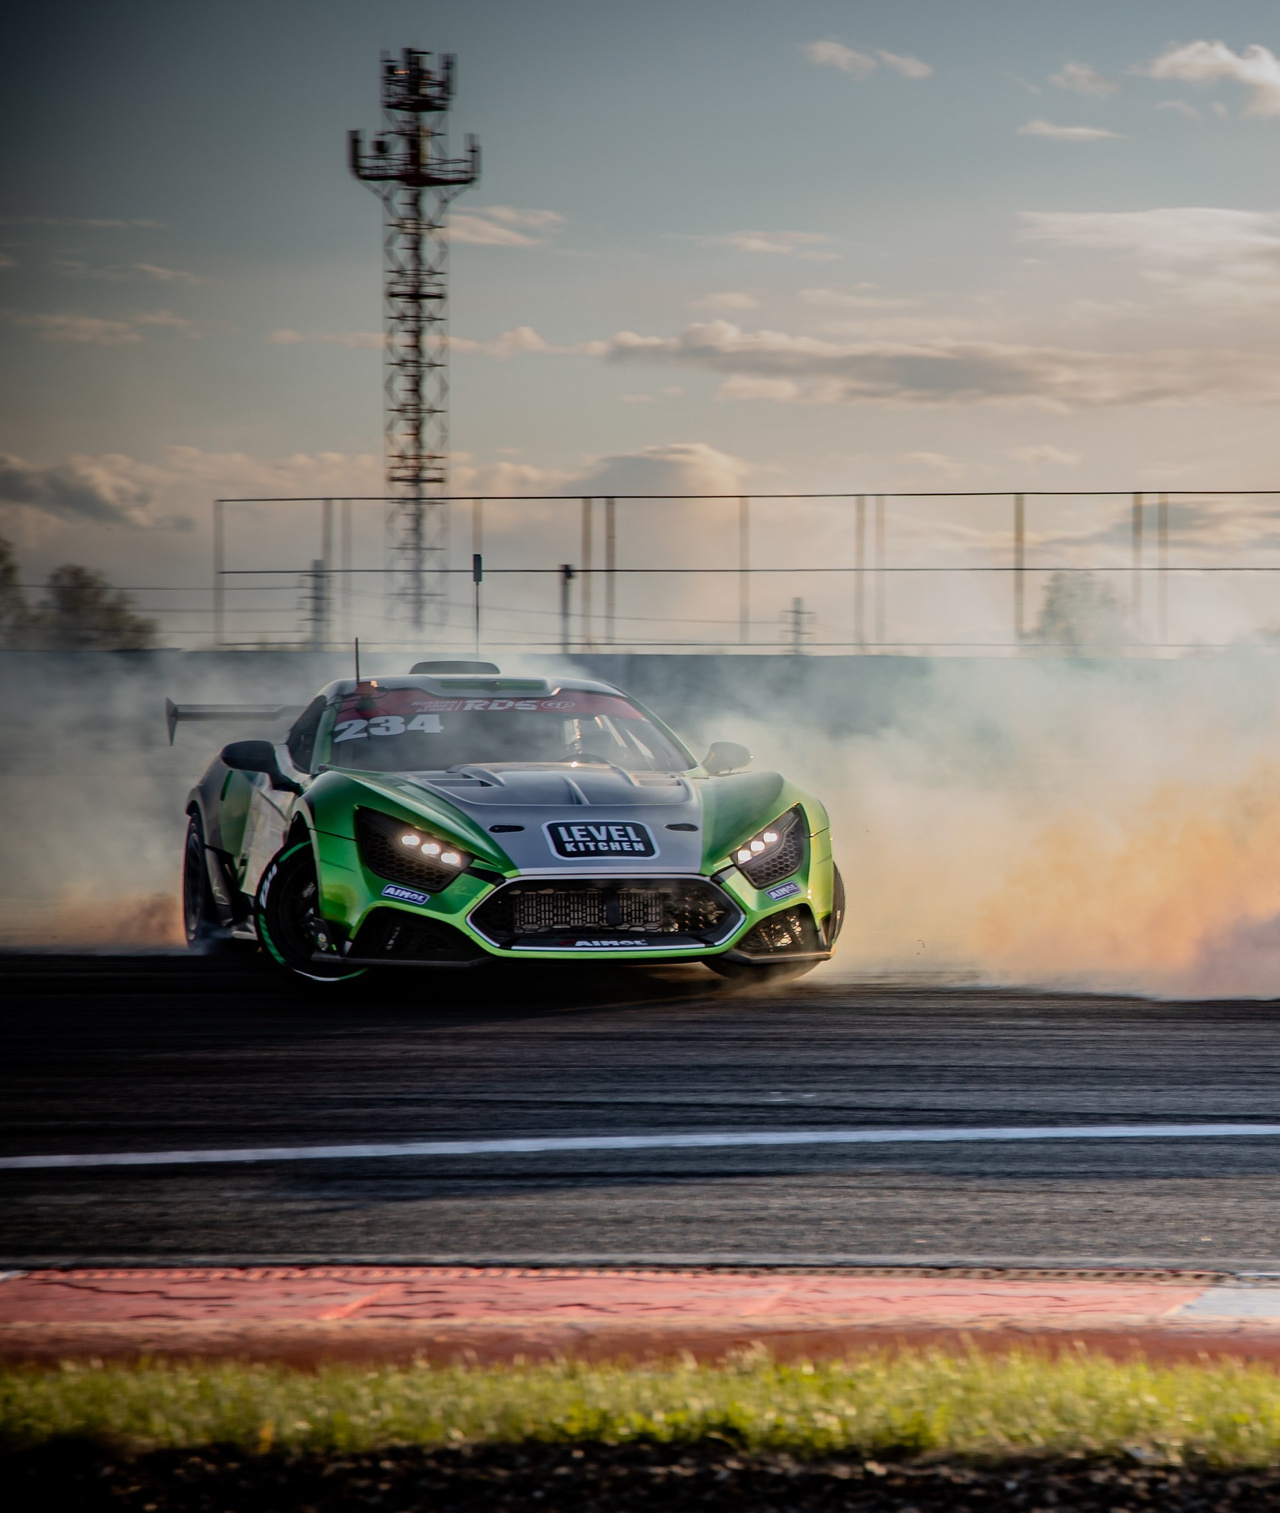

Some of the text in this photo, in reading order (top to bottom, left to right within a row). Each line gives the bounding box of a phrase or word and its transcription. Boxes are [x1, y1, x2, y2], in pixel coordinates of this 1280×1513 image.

[463, 699, 539, 711] RDS
[333, 713, 444, 744] 234
[558, 825, 642, 842] LEVEL
[564, 842, 646, 852] KITCHEN
[384, 887, 425, 902] AIMOL
[574, 939, 648, 947] AIMOL
